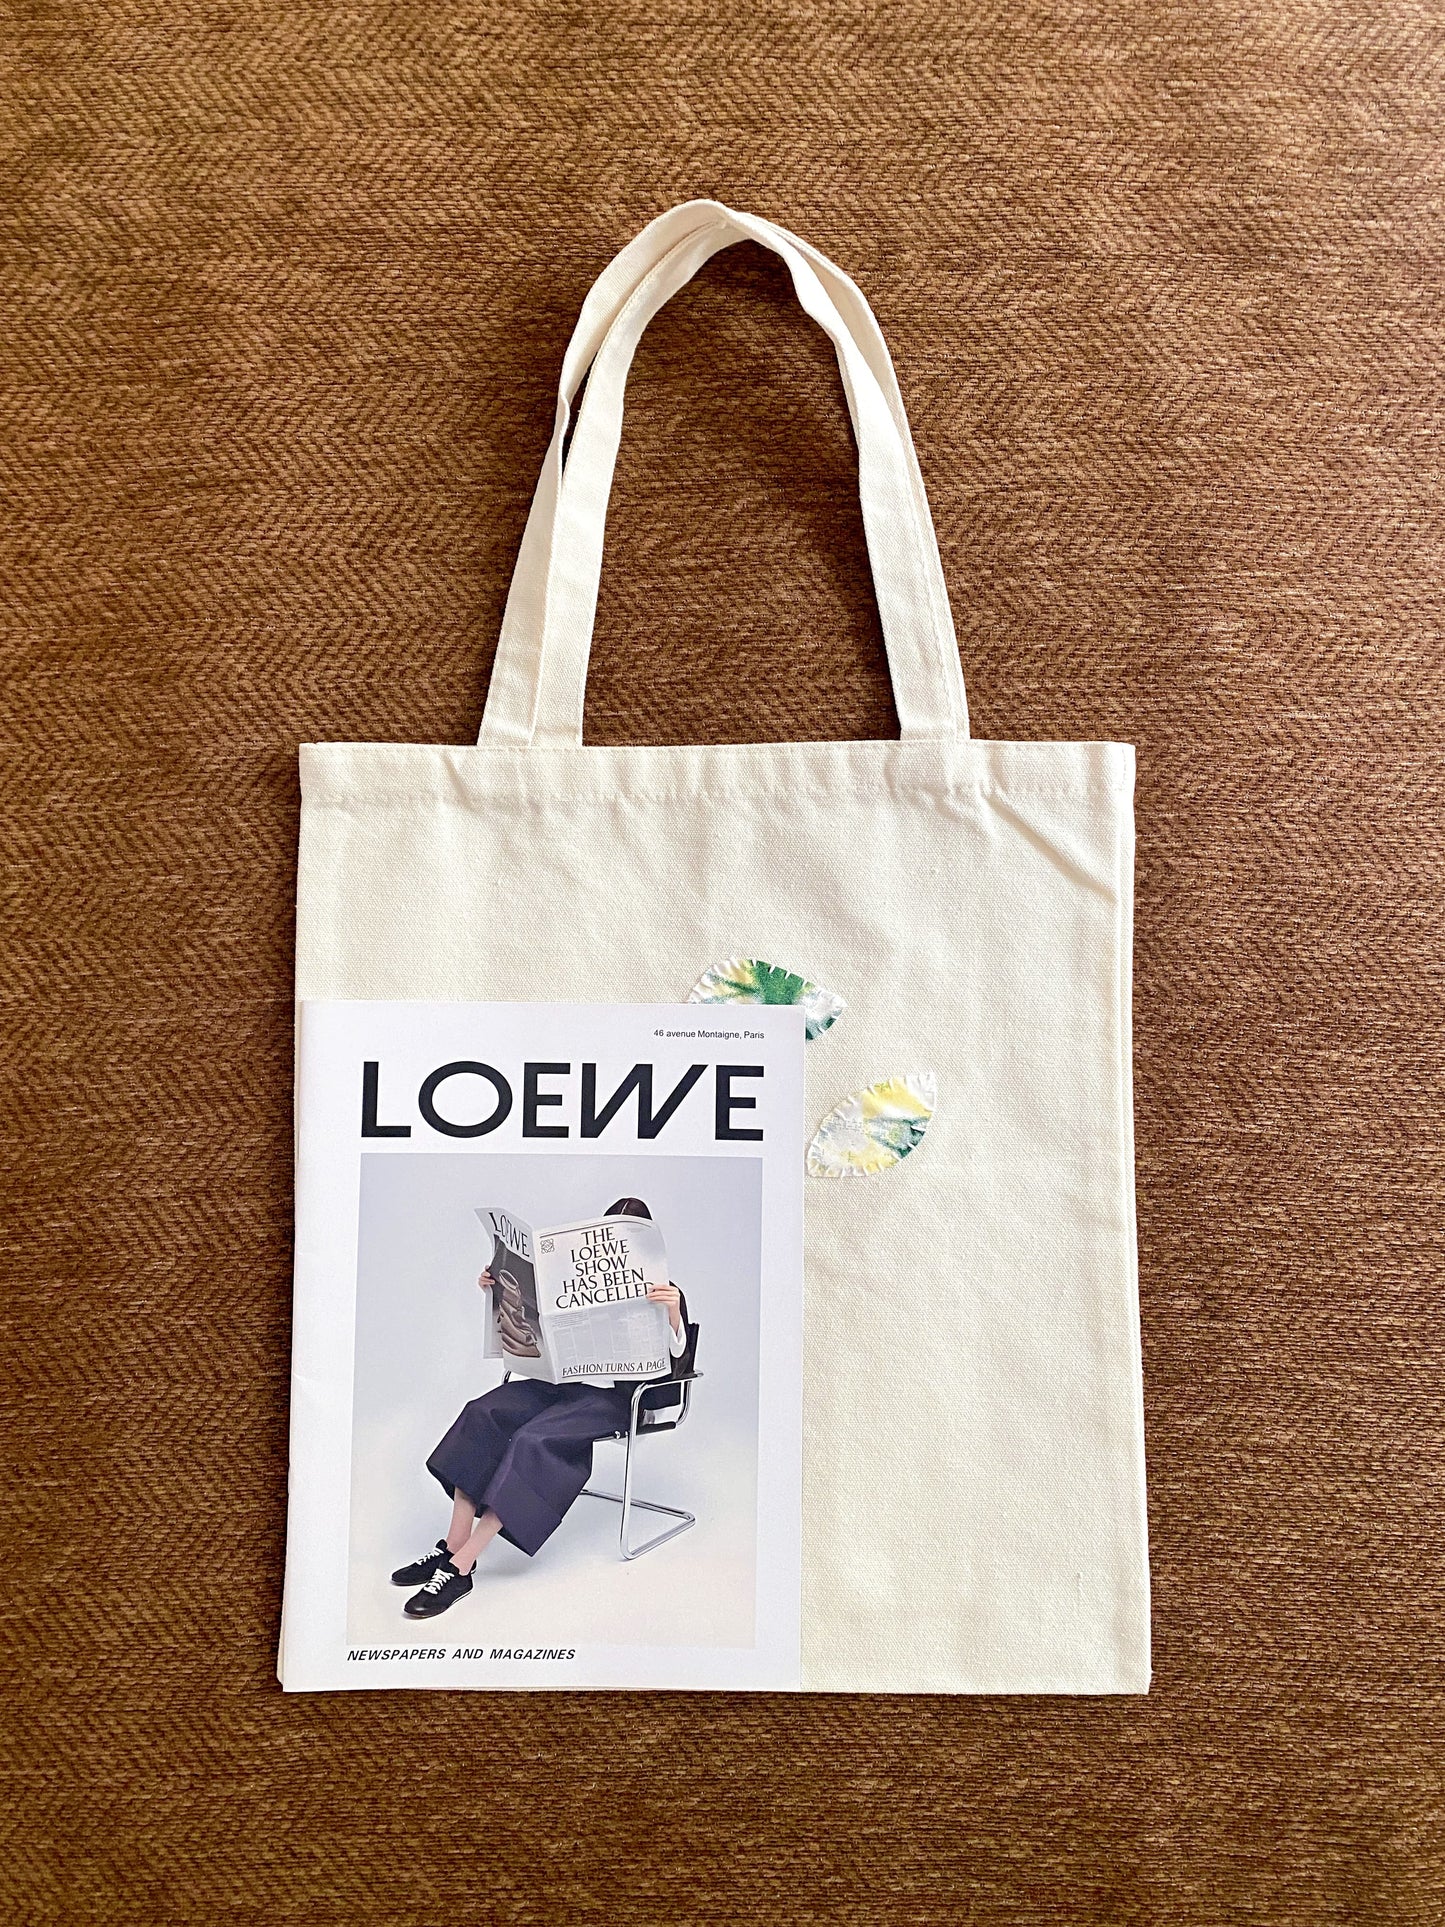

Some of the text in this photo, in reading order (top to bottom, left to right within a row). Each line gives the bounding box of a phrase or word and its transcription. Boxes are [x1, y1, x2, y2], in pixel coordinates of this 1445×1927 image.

[653, 1029, 664, 1037] 46
[697, 1030, 742, 1040] Montaigne,
[743, 1031, 765, 1039] Paris
[361, 1060, 765, 1141] LOEWE
[581, 1226, 616, 1246] THE
[570, 1239, 630, 1263] LOEWE
[575, 1254, 628, 1278] SHOW
[563, 1267, 645, 1294] HAS BEEN
[562, 1358, 666, 1376] FASHION TURNS A PAGE
[347, 1649, 576, 1661] NEWSPAPERS AND MAGAZINES
